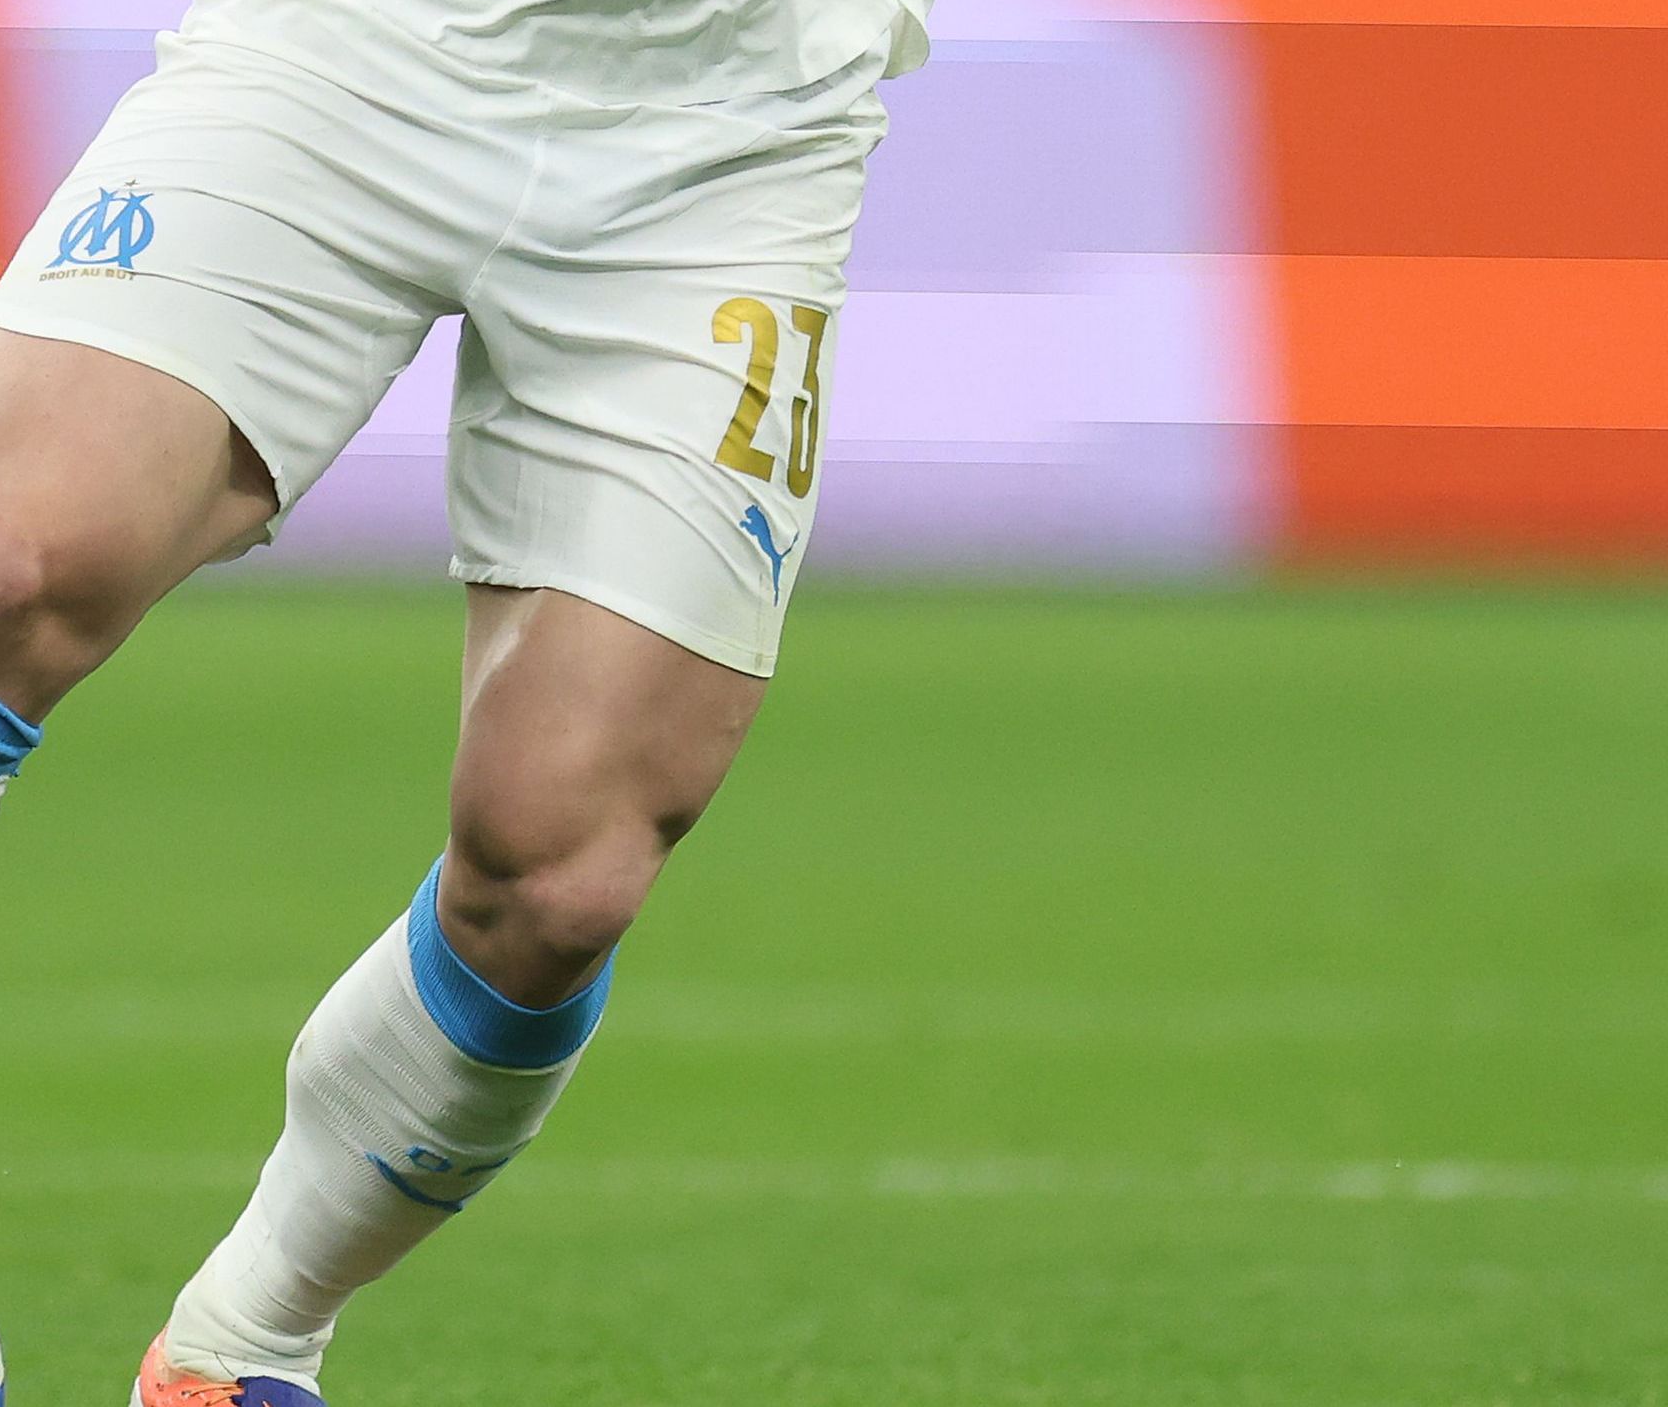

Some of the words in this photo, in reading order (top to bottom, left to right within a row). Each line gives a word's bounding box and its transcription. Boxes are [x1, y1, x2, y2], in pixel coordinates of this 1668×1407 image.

[38, 269, 78, 282] DROIT
[79, 268, 101, 279] AU
[712, 296, 829, 500] 23
